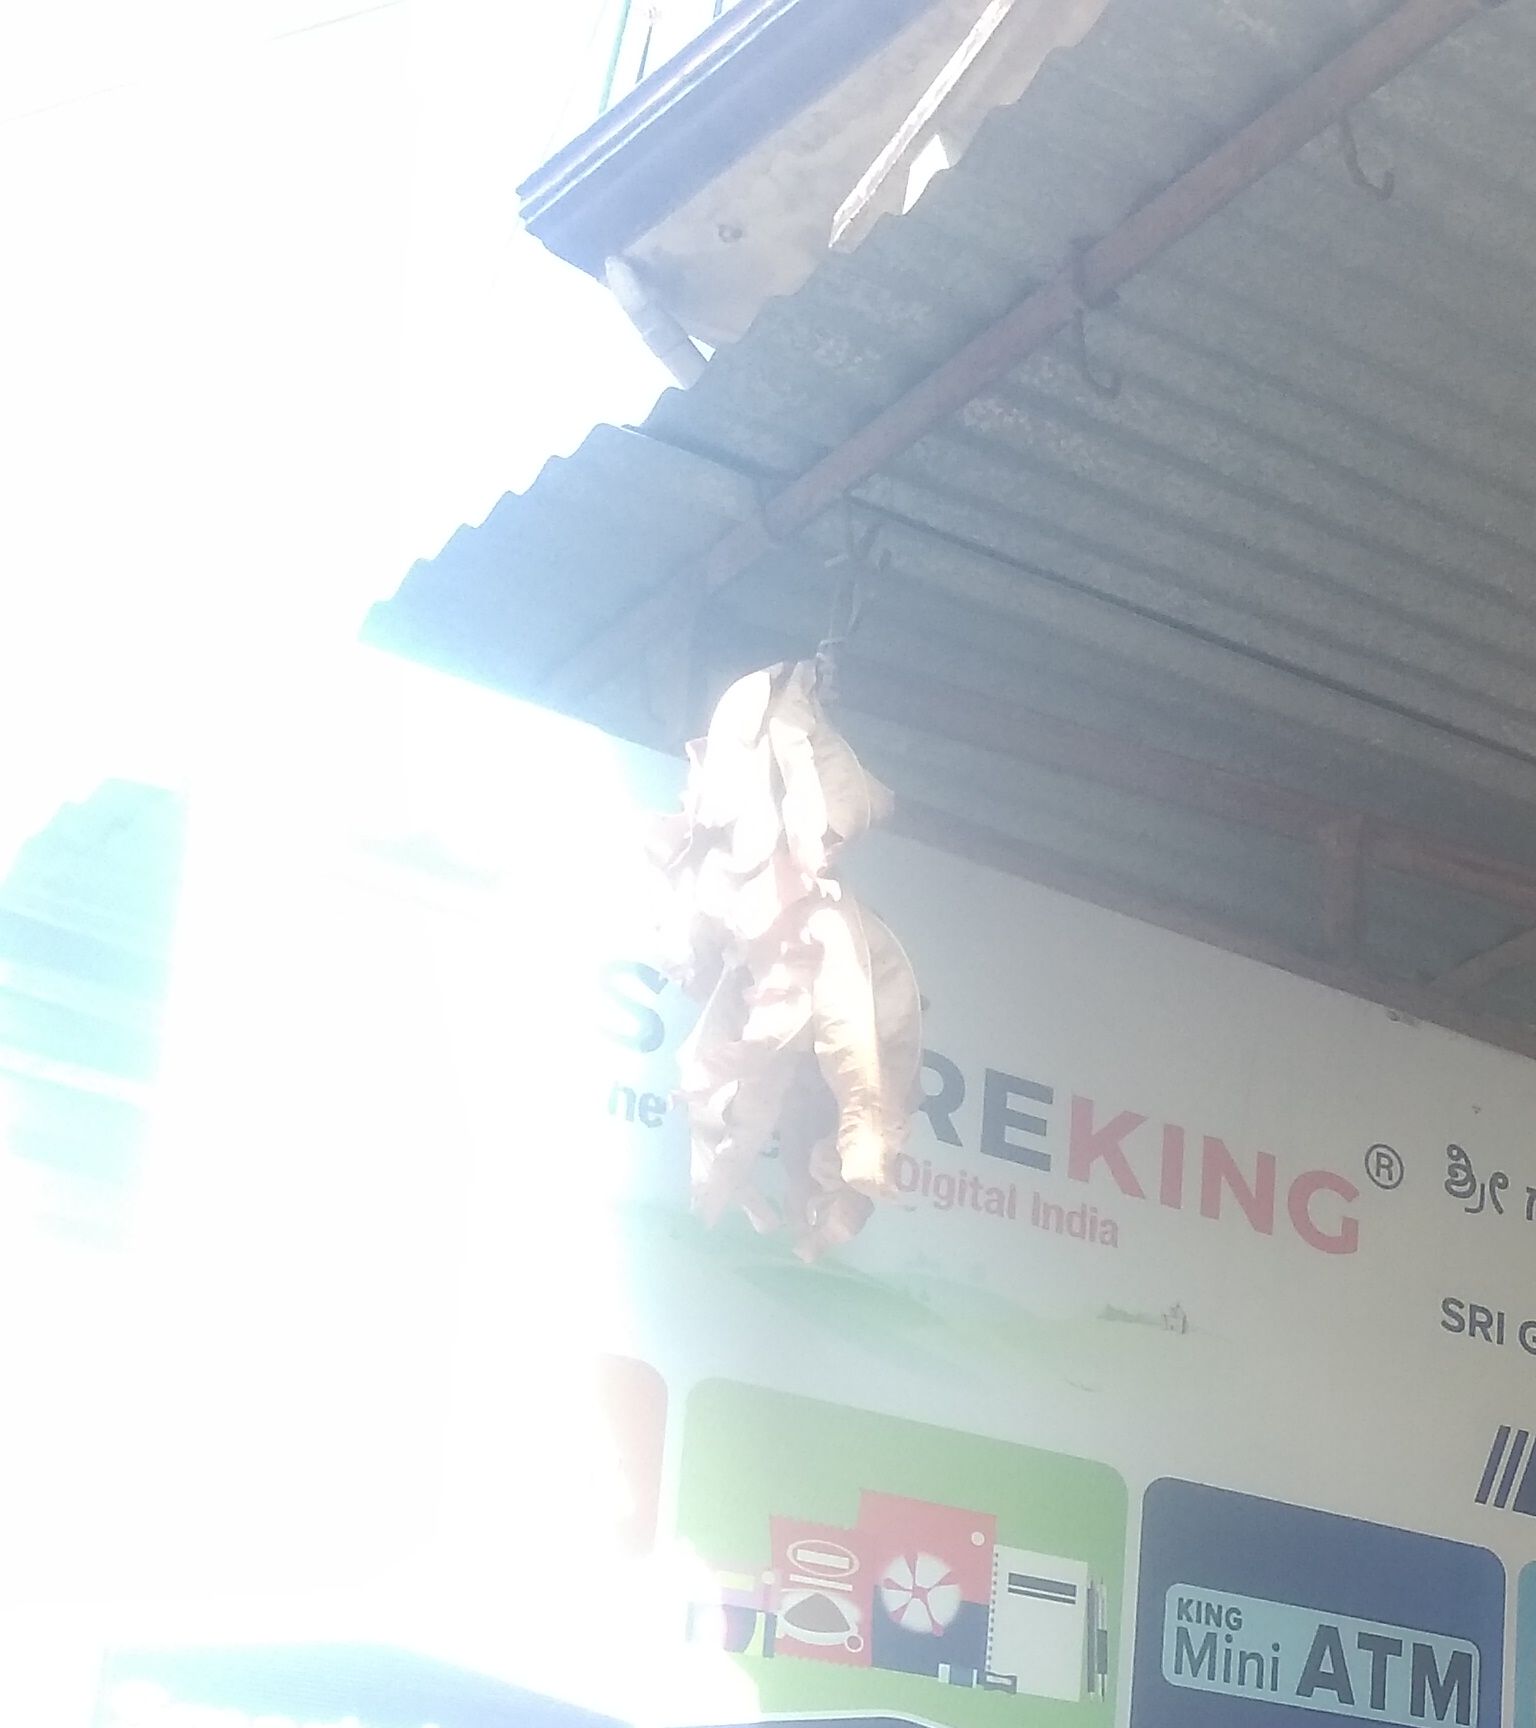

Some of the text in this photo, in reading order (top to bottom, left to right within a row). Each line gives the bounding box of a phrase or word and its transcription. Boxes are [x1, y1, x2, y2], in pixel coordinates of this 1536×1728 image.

[894, 1152, 1121, 1250] Digital India
[1444, 1144, 1508, 1214] ಶ್ರೀ
[1440, 1297, 1507, 1346] SRI
[1177, 1596, 1243, 1633] KING
[1174, 1623, 1474, 1728] Mini ATM
